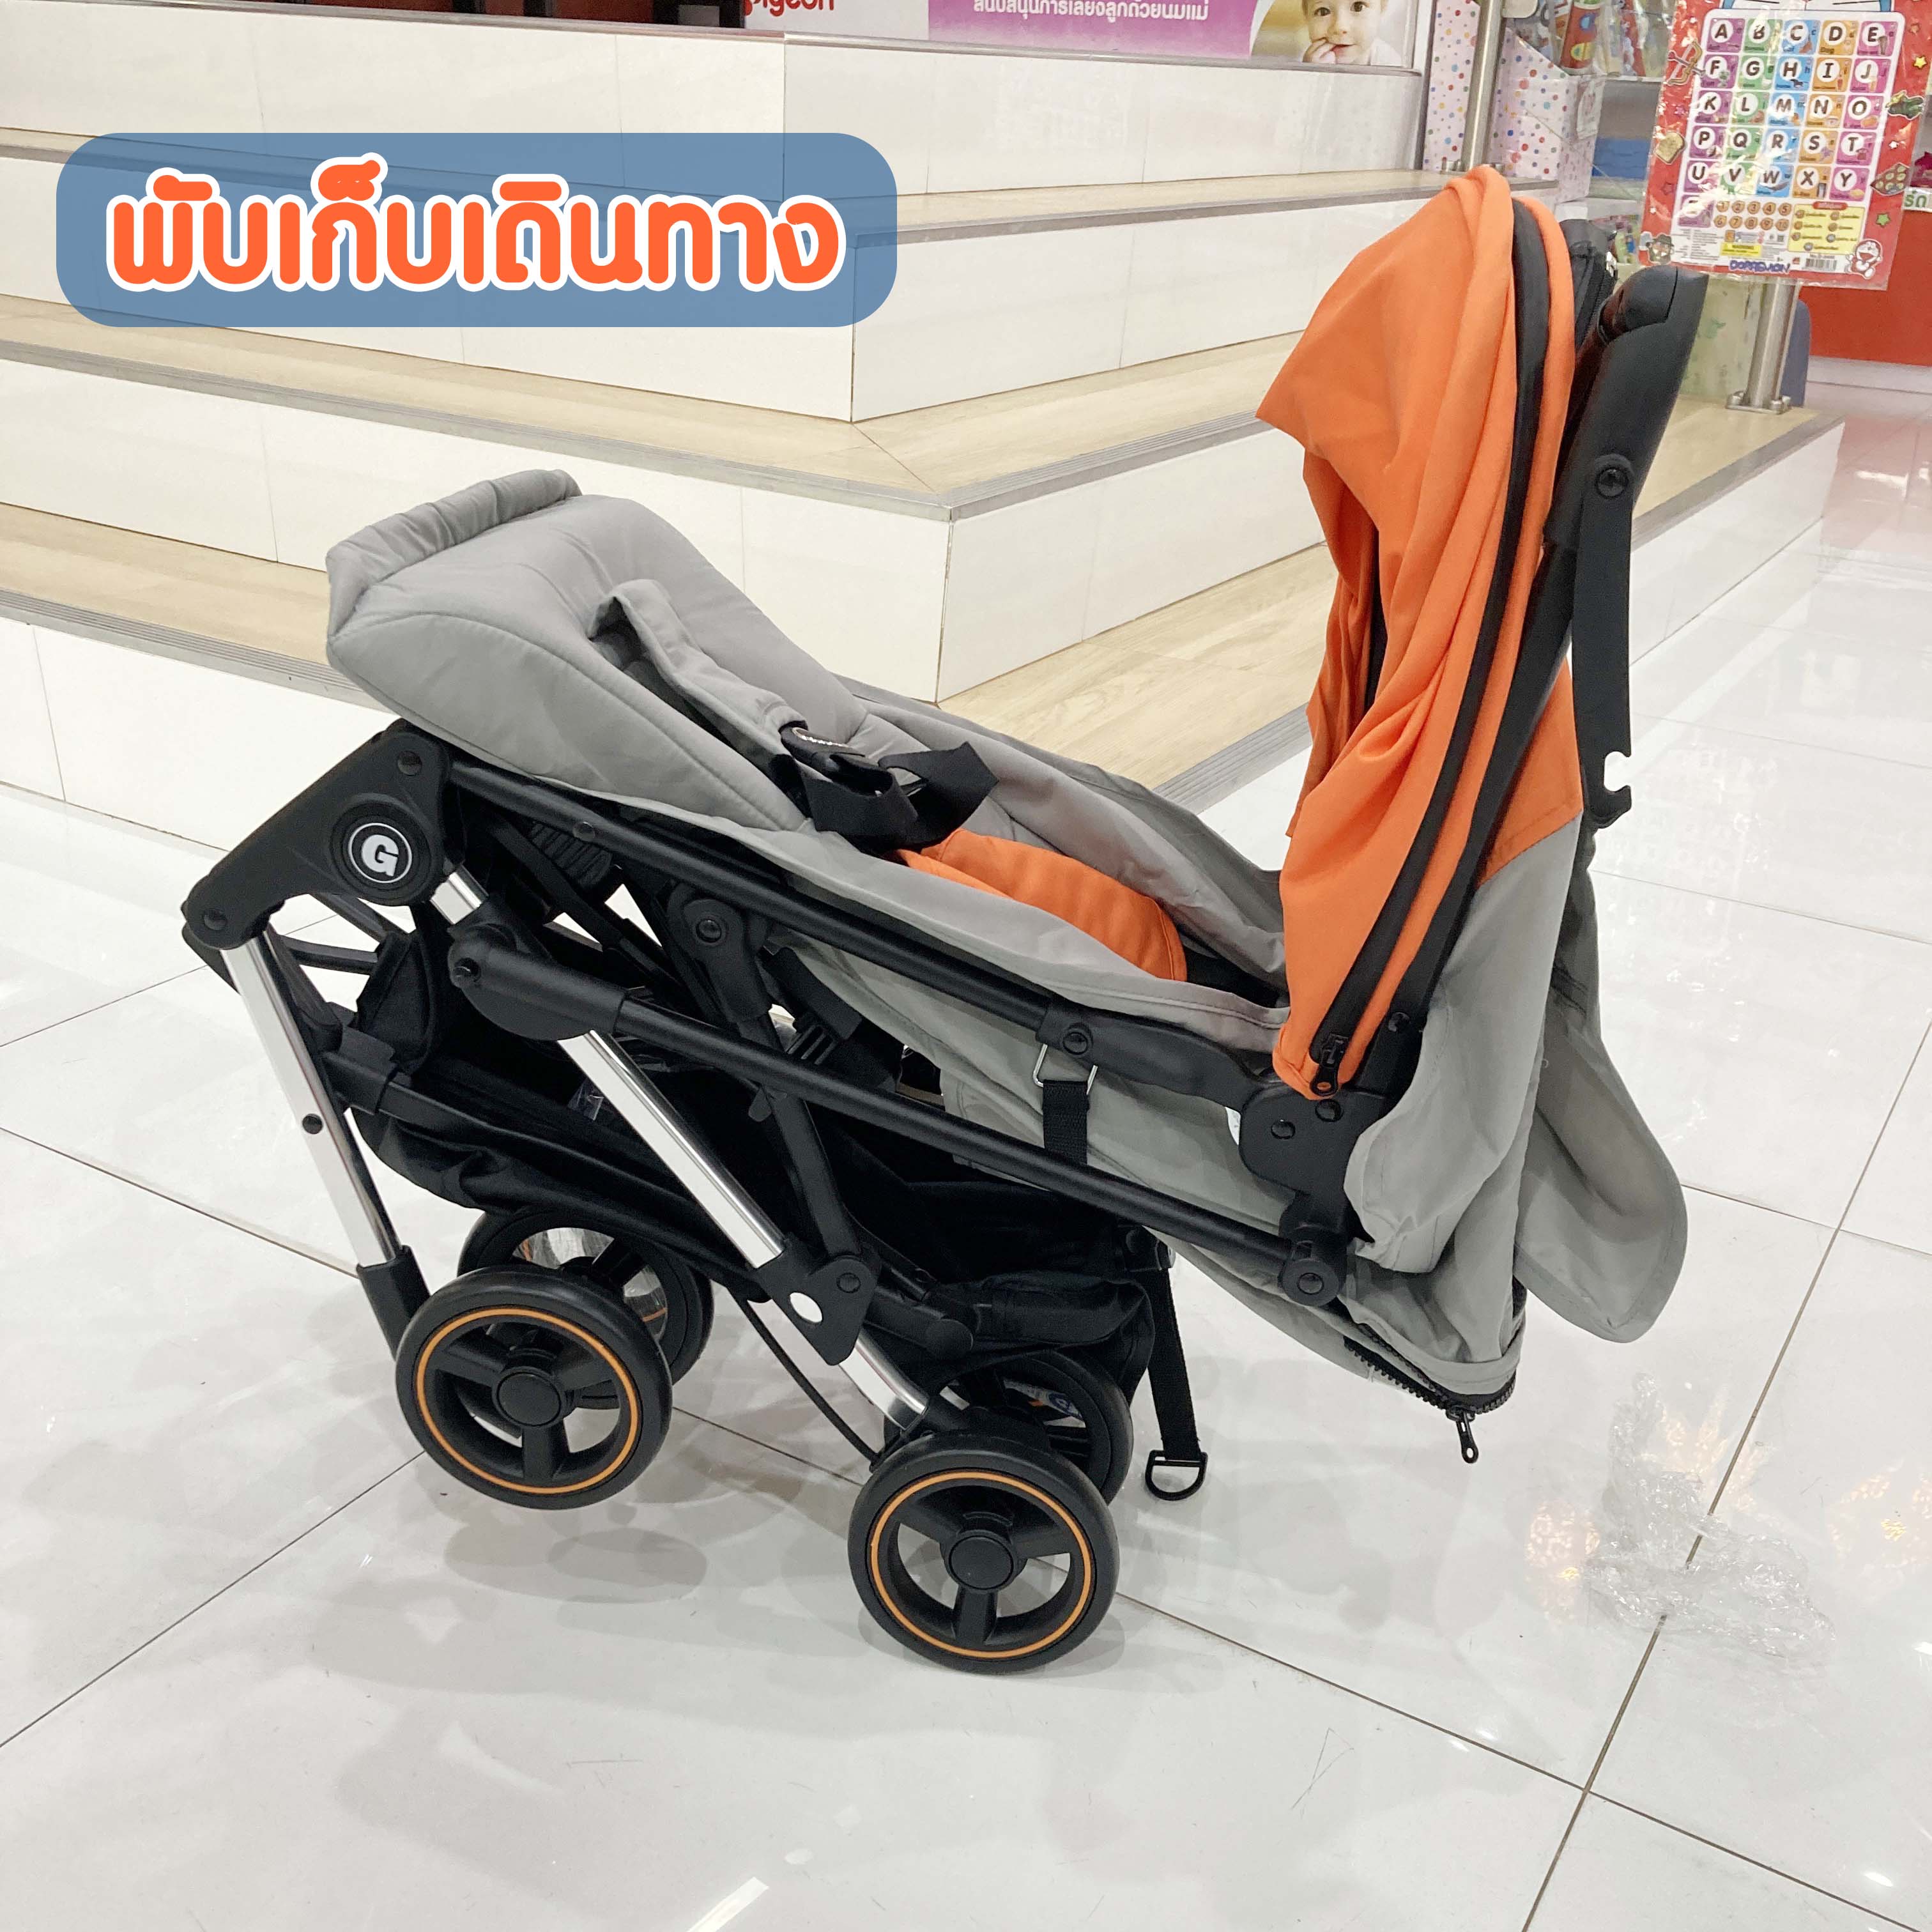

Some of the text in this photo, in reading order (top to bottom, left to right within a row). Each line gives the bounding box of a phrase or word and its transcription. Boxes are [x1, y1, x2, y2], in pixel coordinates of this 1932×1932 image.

[1714, 23, 1728, 38] A
[1790, 25, 1804, 41] C
[1828, 26, 1843, 42] D
[1867, 27, 1878, 42] E
[1710, 60, 1871, 79] F G H I J
[1705, 96, 1867, 115] K L M N O
[1698, 131, 1859, 152] P Q R S T
[1692, 165, 1853, 187] U V W X Y
[361, 834, 399, 877] G
